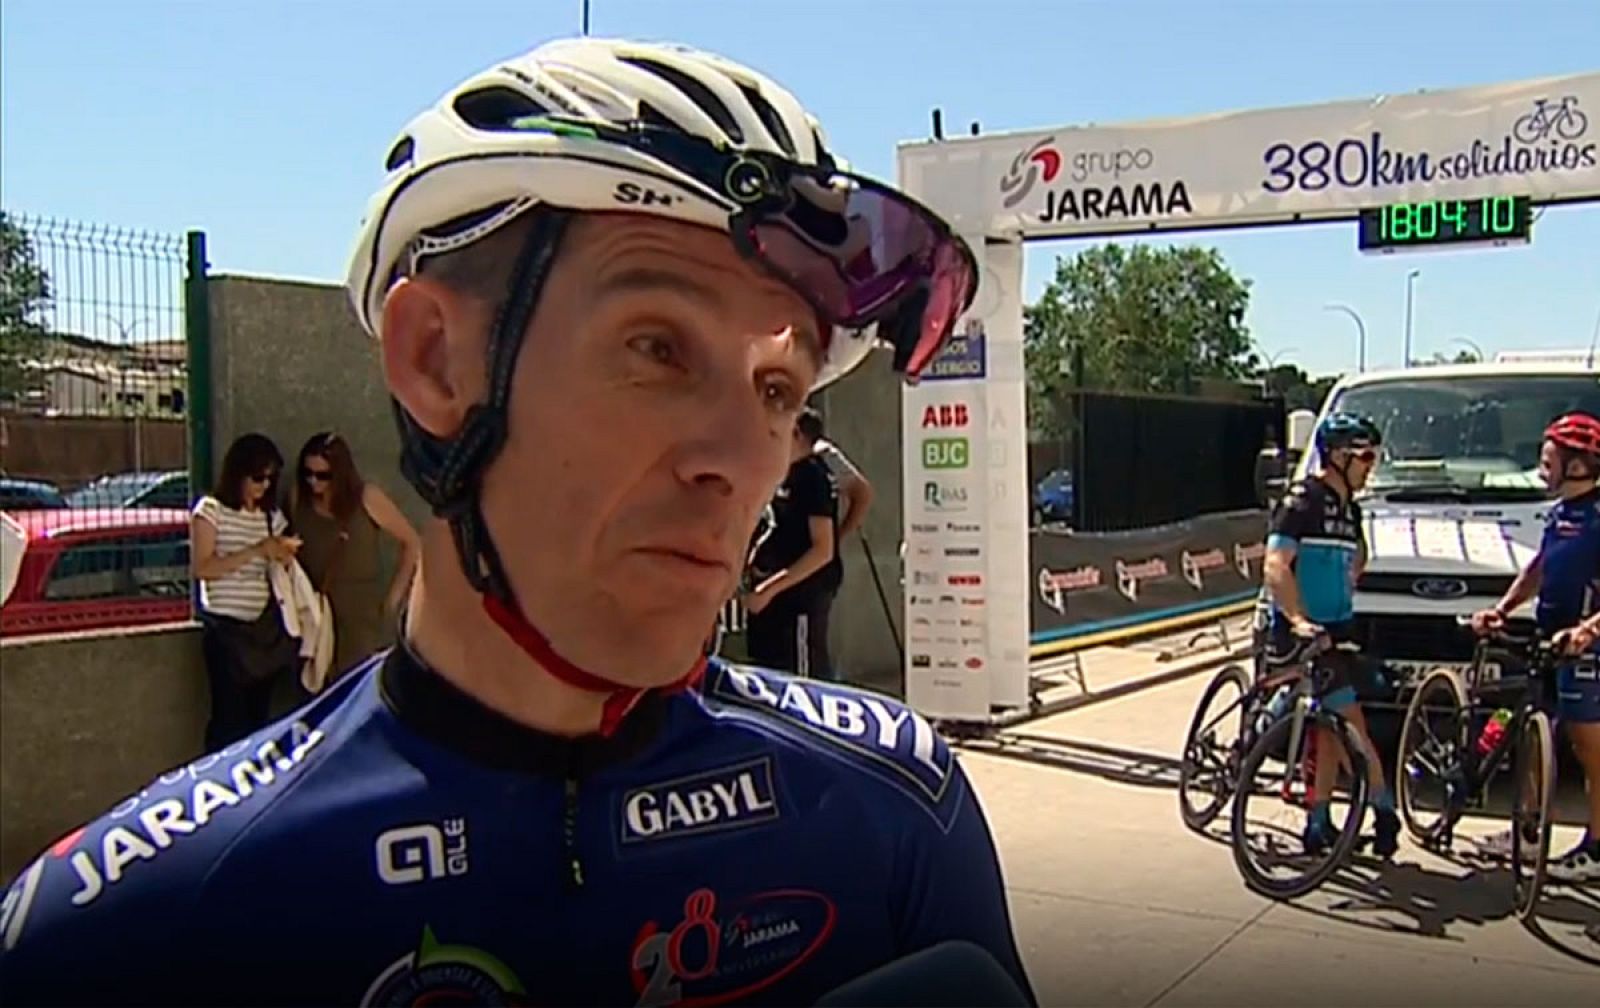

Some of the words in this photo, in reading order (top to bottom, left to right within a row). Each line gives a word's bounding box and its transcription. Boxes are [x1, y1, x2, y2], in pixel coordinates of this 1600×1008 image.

[1072, 148, 1153, 183] grupo
[1439, 136, 1597, 181] solidarios
[1039, 180, 1193, 222] JARAMA
[922, 403, 969, 430] ABB
[926, 442, 966, 465] BJC
[72, 720, 324, 905] JARAMA
[626, 772, 773, 836] GABYL
